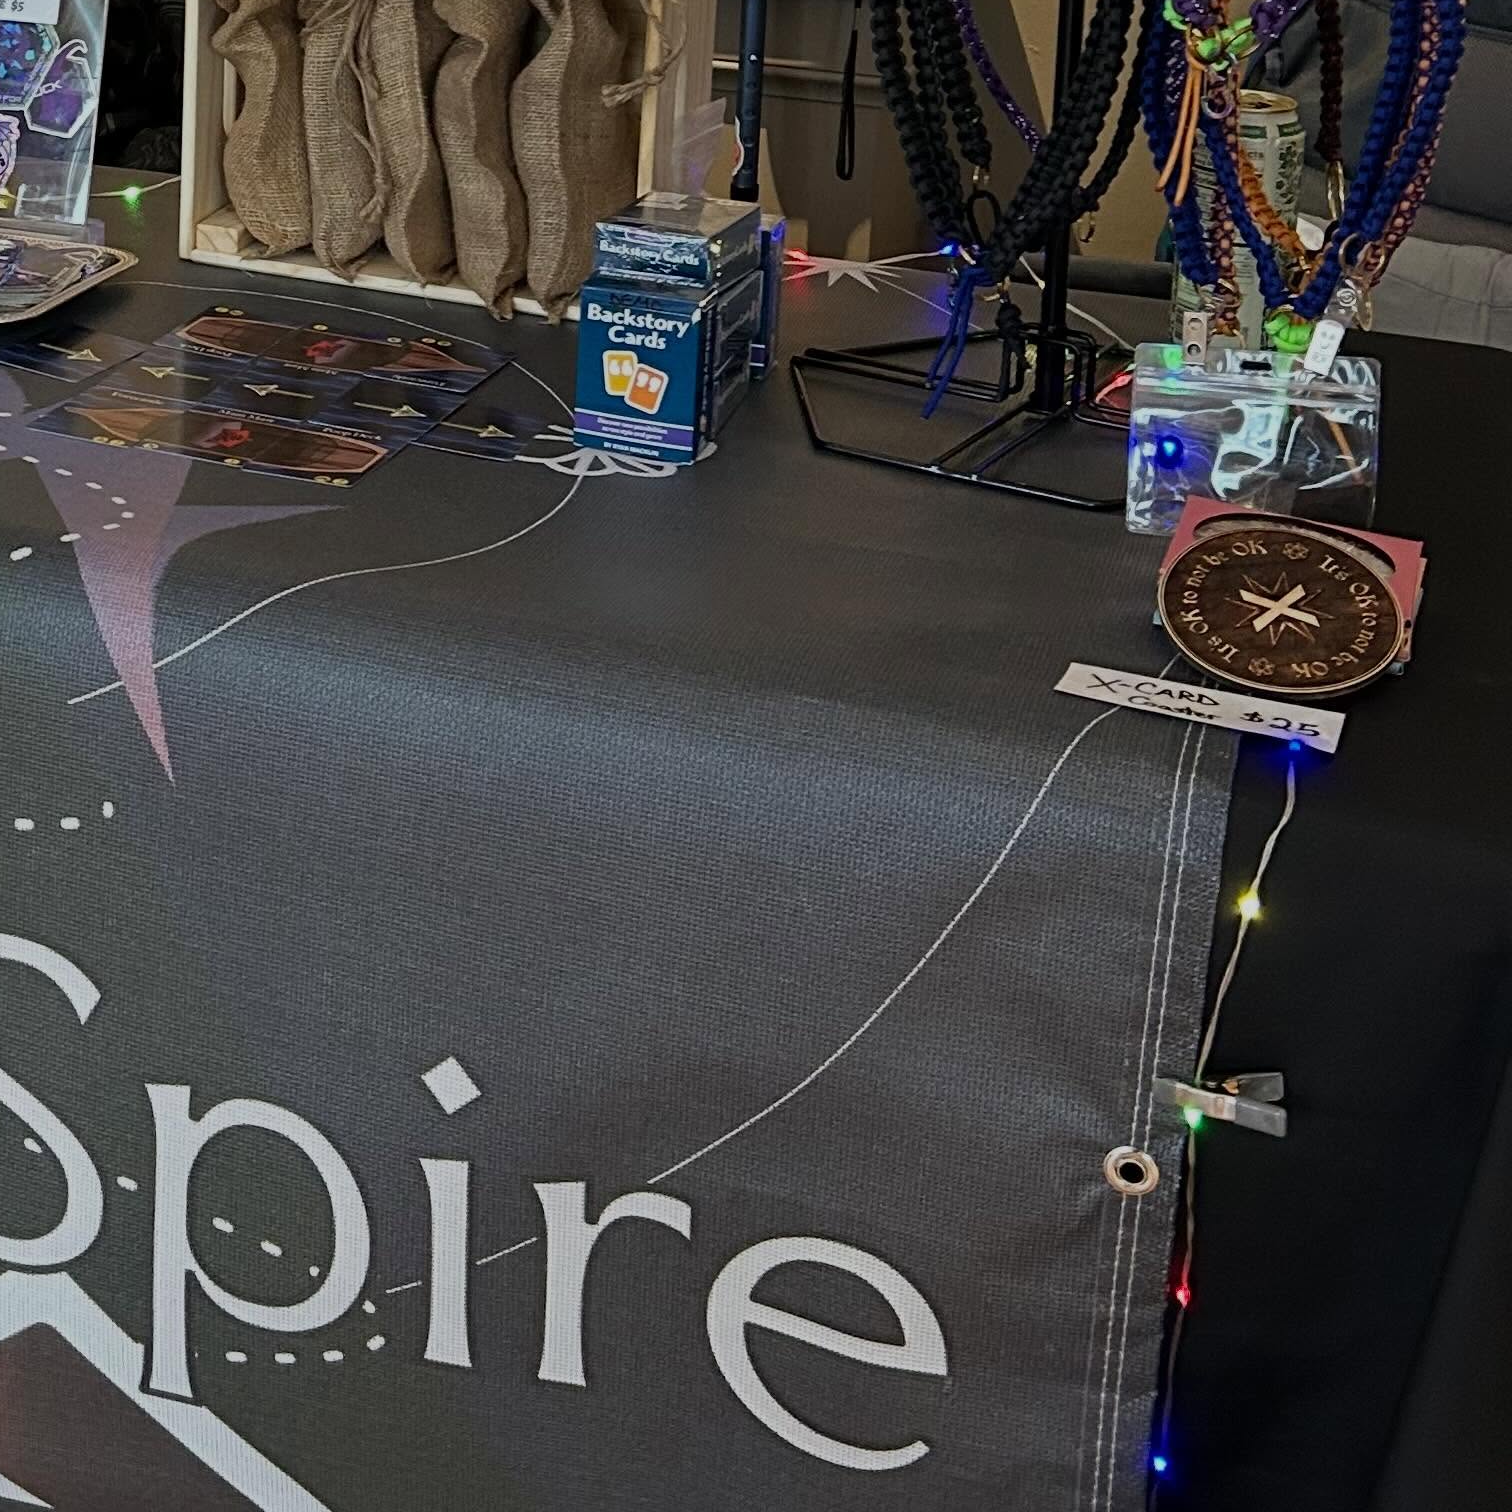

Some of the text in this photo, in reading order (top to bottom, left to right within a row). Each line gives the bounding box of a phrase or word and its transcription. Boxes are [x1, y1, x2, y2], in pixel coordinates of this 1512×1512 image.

[599, 240, 700, 267] Backstory Cards
[587, 302, 689, 338] Backstory
[608, 325, 666, 351] Cards
[1180, 539, 1268, 664] It's OK to not be OK
[1088, 672, 1321, 738] X-CARD $25
